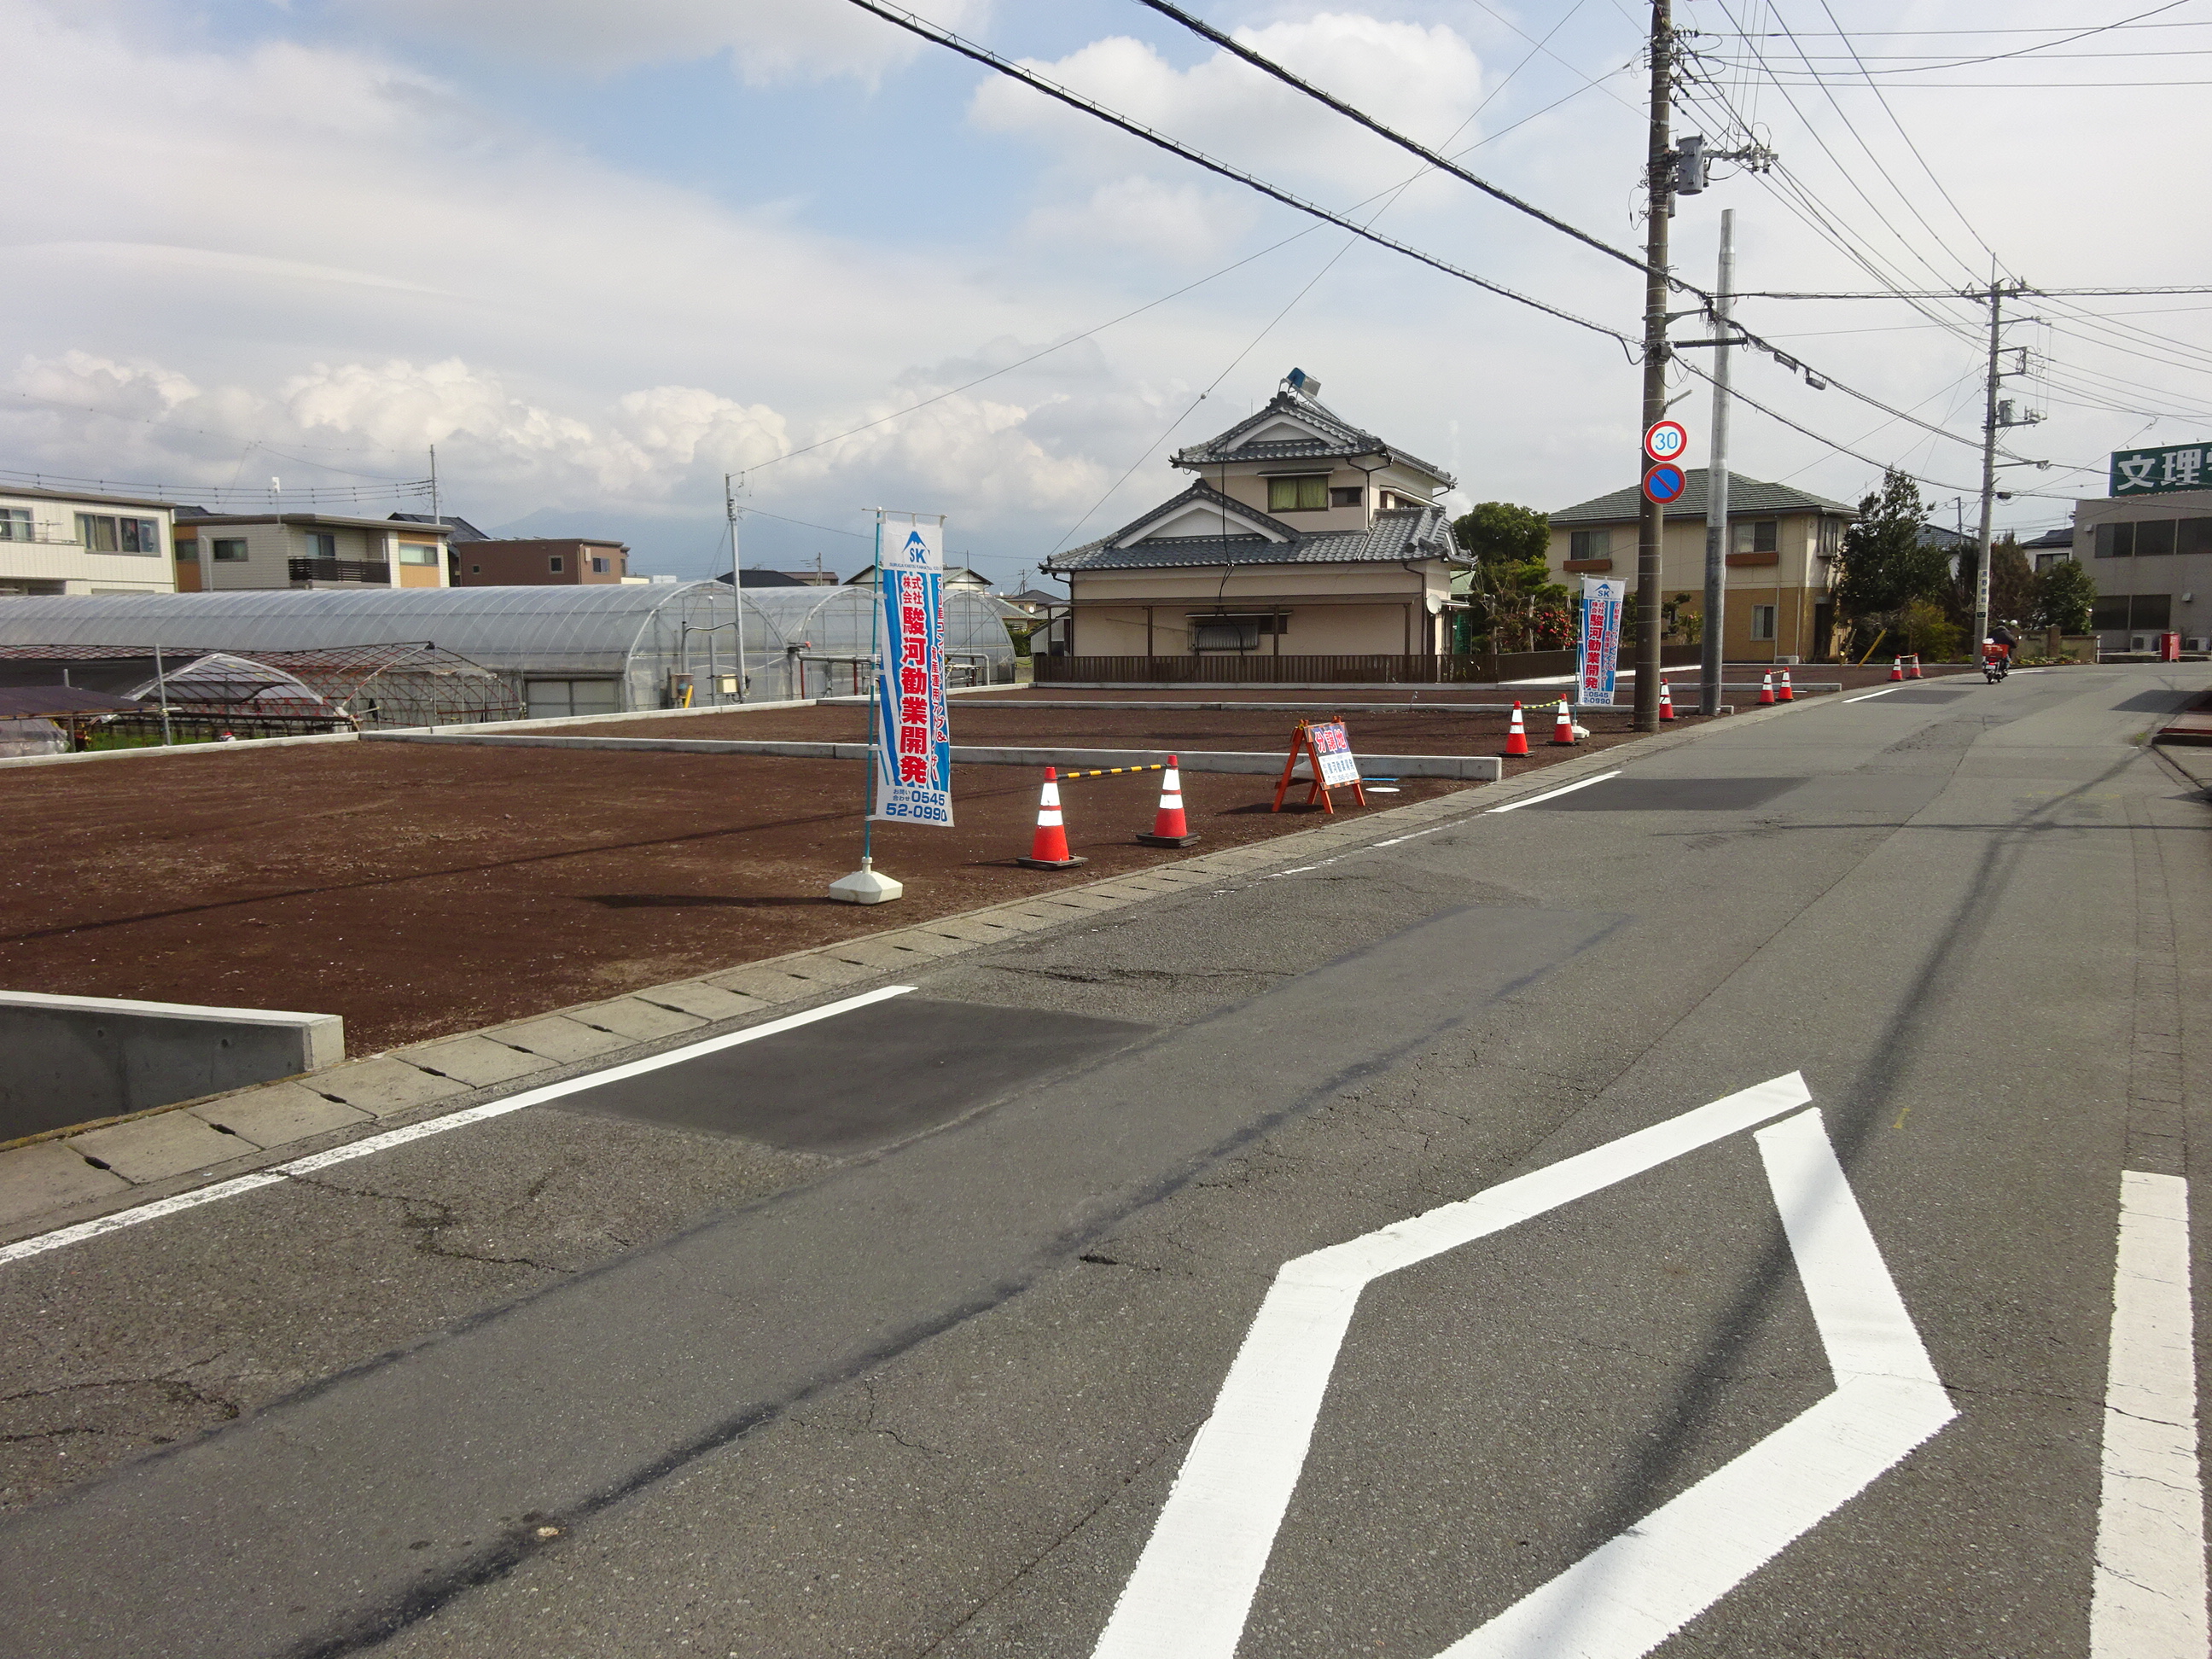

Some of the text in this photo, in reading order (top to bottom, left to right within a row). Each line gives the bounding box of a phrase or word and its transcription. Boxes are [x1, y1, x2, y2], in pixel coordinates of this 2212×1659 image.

[1655, 432, 1678, 451] 30
[2116, 448, 2212, 492] 文理
[910, 548, 927, 564] SK
[1585, 614, 1604, 690] 駿河勧業開発
[900, 607, 928, 783] 駿河勧業開発
[1315, 729, 1347, 753] 分譲地
[911, 790, 945, 806] 0545
[886, 803, 947, 822] 52-0990
